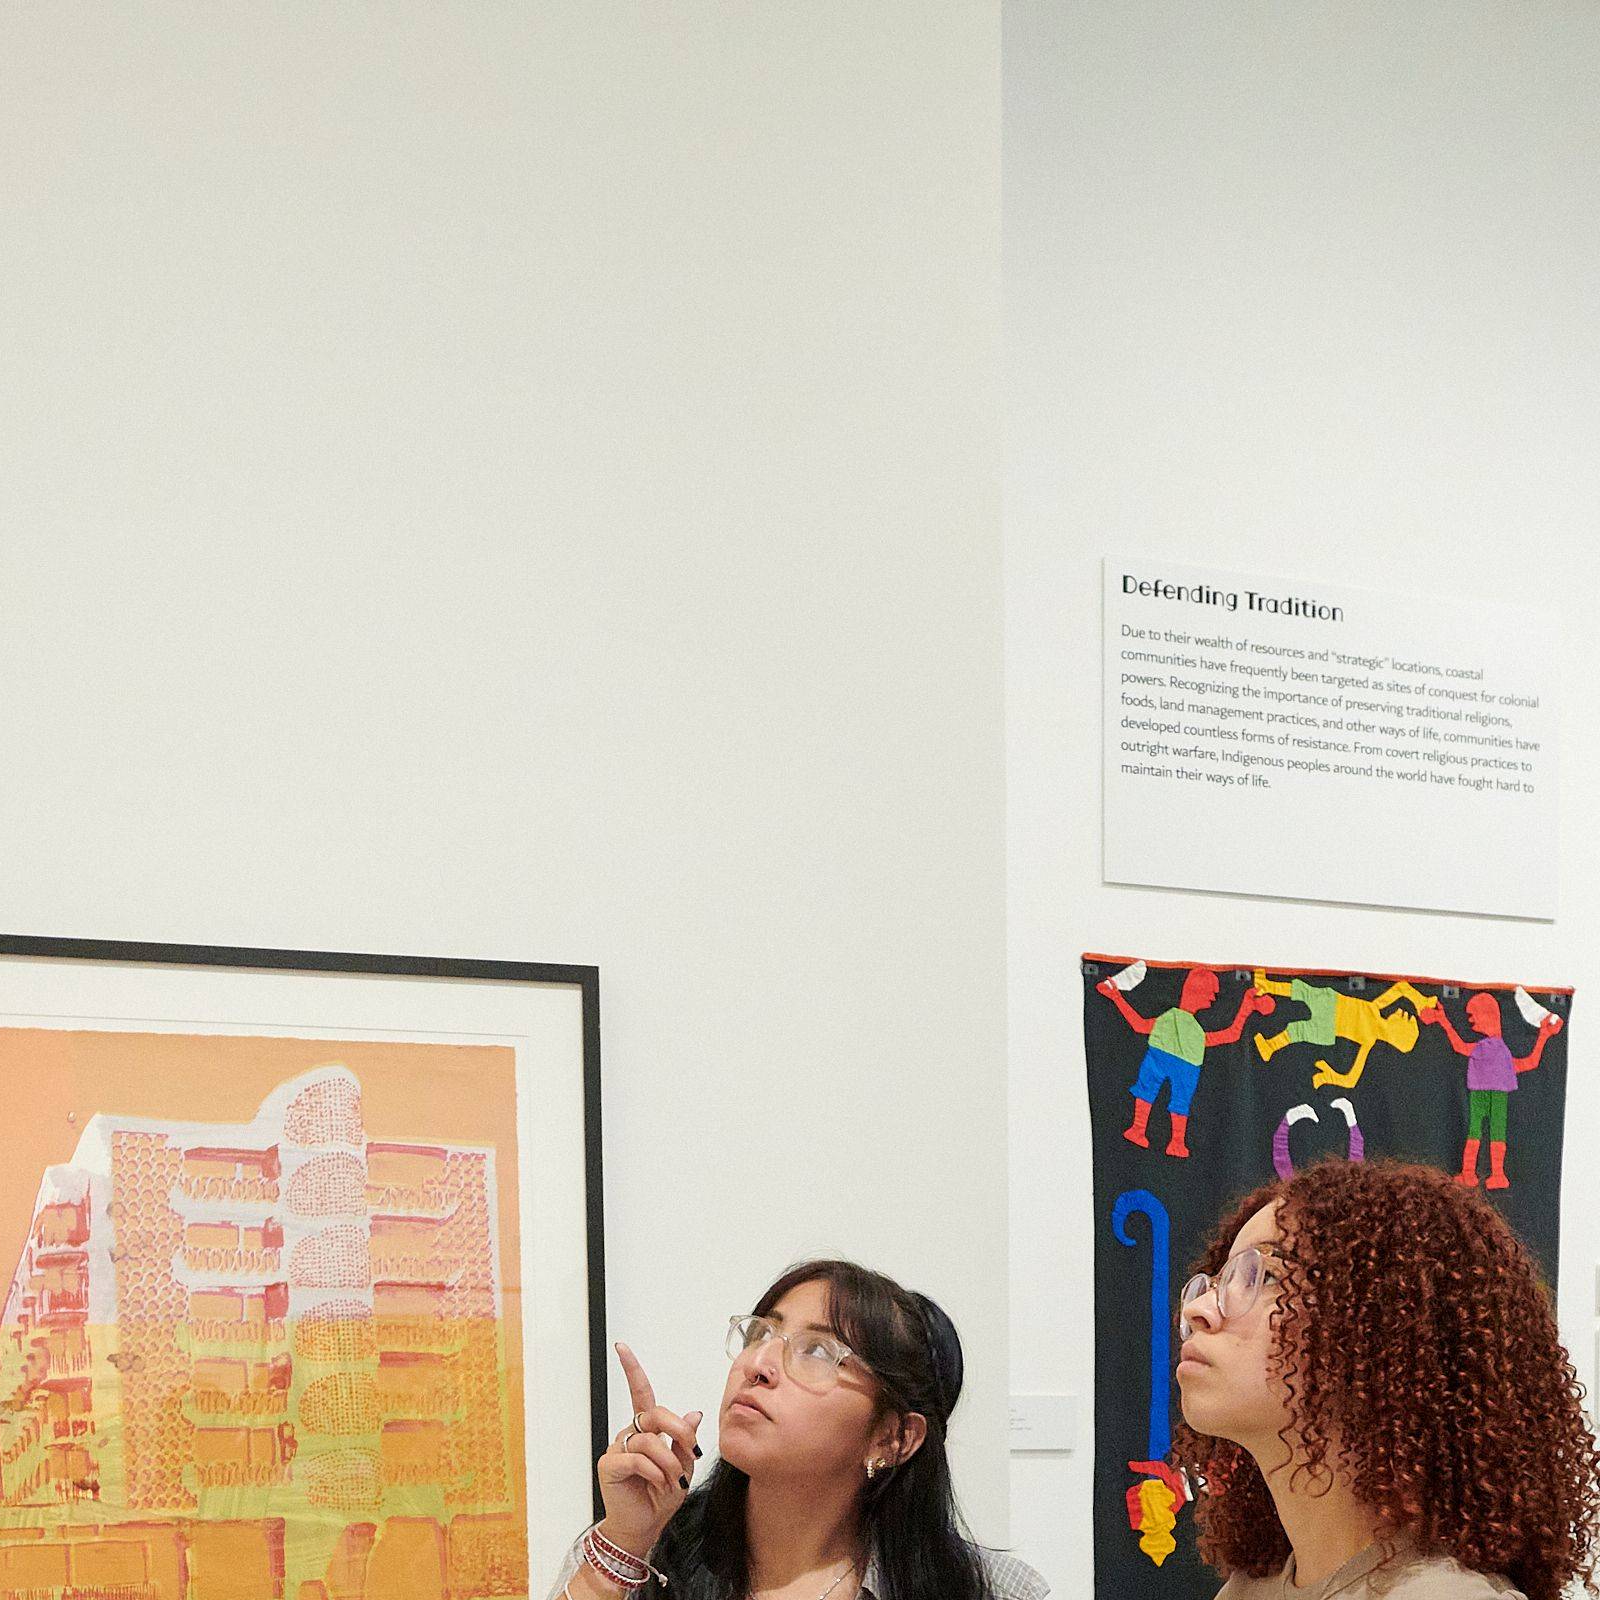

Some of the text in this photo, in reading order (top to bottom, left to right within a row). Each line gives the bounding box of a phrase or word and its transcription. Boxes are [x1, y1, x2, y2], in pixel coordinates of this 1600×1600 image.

[1122, 574, 1344, 622] Defending Tradition
[1121, 624, 1484, 681] Due to their wealth of resources and “strategic” locations, coastal
[1121, 650, 1540, 709] communities have frequently been targeted as sites of conquest for colonial
[1121, 672, 1513, 728] powers. Recognizing the importance of preserving traditional religions,
[1121, 692, 1541, 752] foods, land management practices, and other ways of life, communities have
[1121, 715, 1533, 772] developed countless forms of resistance. From covert religious practices to
[1121, 740, 1535, 794] outright warfare, Indigenous peoples around the world have fought hard to
[1121, 763, 1271, 789] maintain their ways of life.
